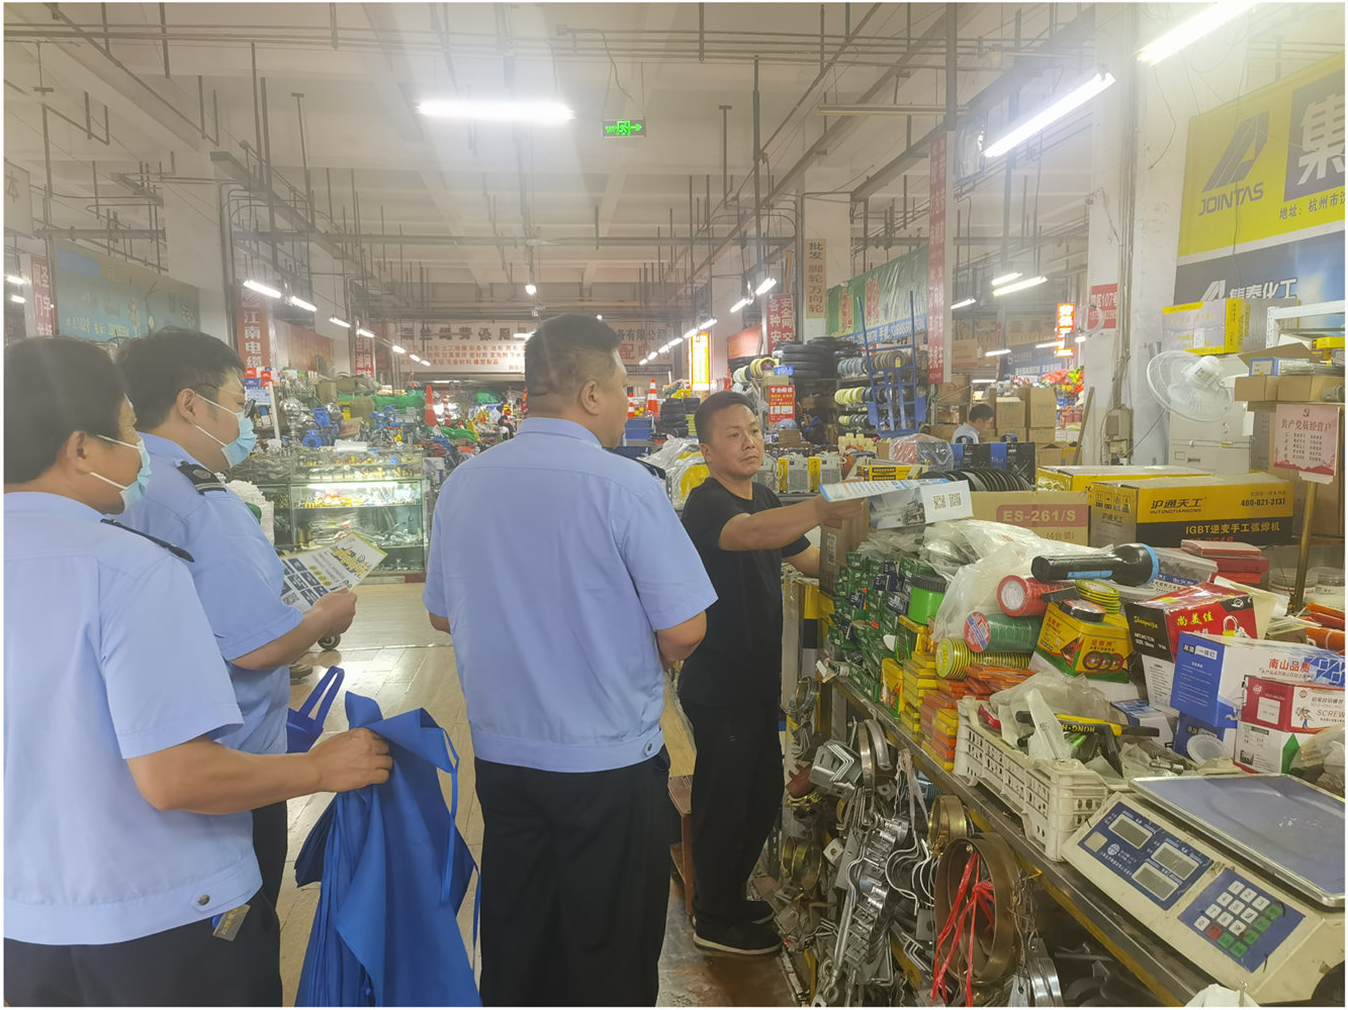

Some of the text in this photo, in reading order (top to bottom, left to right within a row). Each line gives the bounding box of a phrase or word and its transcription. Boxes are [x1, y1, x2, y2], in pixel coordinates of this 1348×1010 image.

[1198, 181, 1265, 217] JOINTAS
[809, 241, 824, 261] 批发
[1281, 418, 1332, 432] 共产党员经营户
[1150, 497, 1287, 510] 沪通天工 400-821-3137
[1002, 509, 1077, 523] ES-261/S
[1176, 611, 1215, 627] 尚美佳
